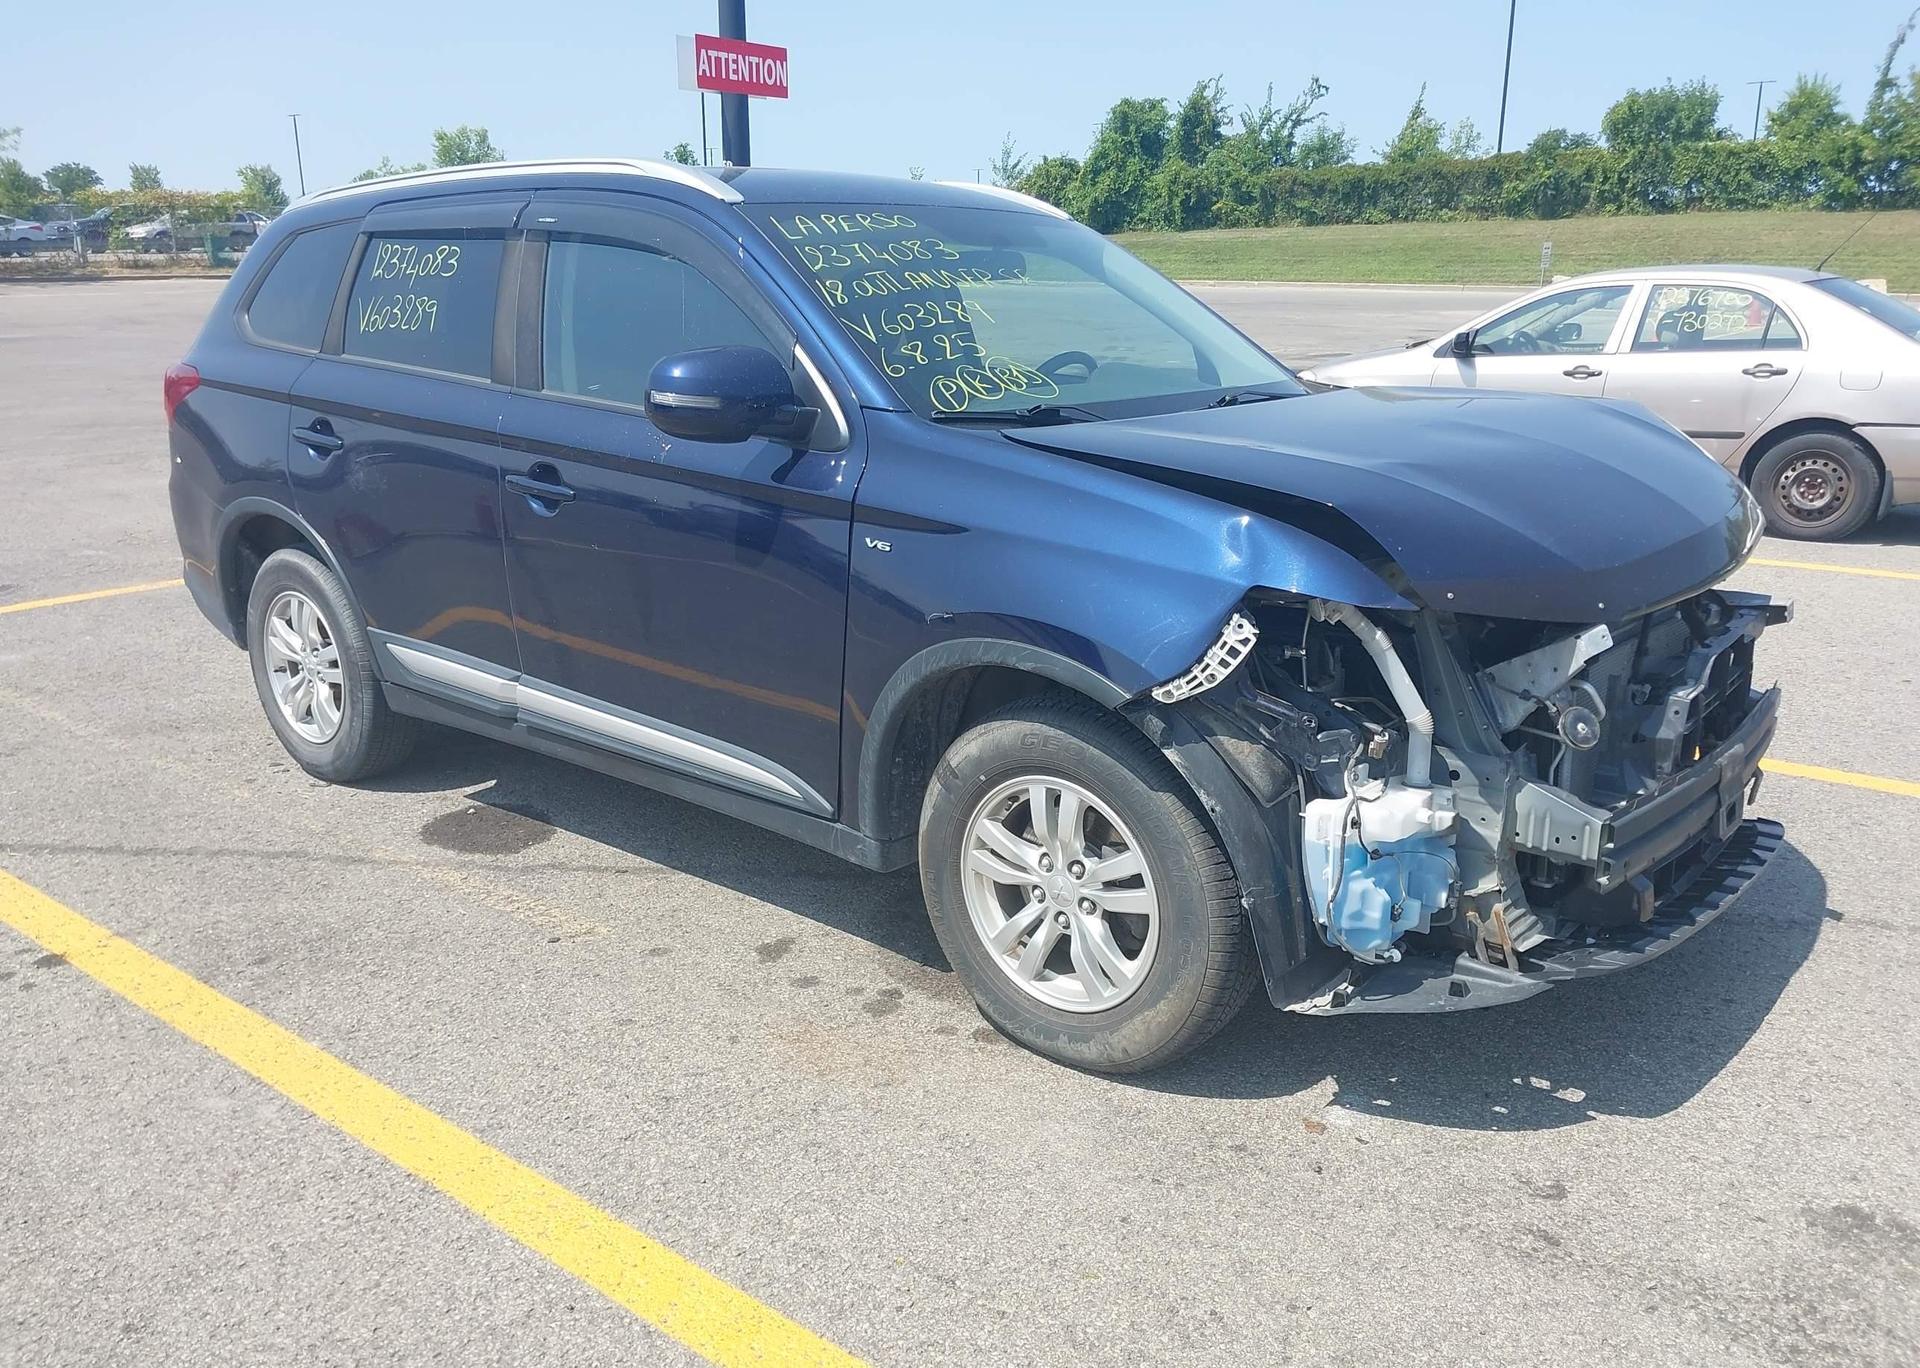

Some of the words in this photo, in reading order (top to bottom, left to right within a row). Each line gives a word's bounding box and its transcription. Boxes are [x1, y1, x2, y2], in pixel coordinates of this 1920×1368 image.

[698, 48, 788, 88] ATTENTION
[769, 215, 822, 240] LA
[820, 212, 917, 235] PERSO
[369, 240, 462, 289] 12374083
[793, 238, 960, 273] 12374083
[864, 536, 894, 553] V6
